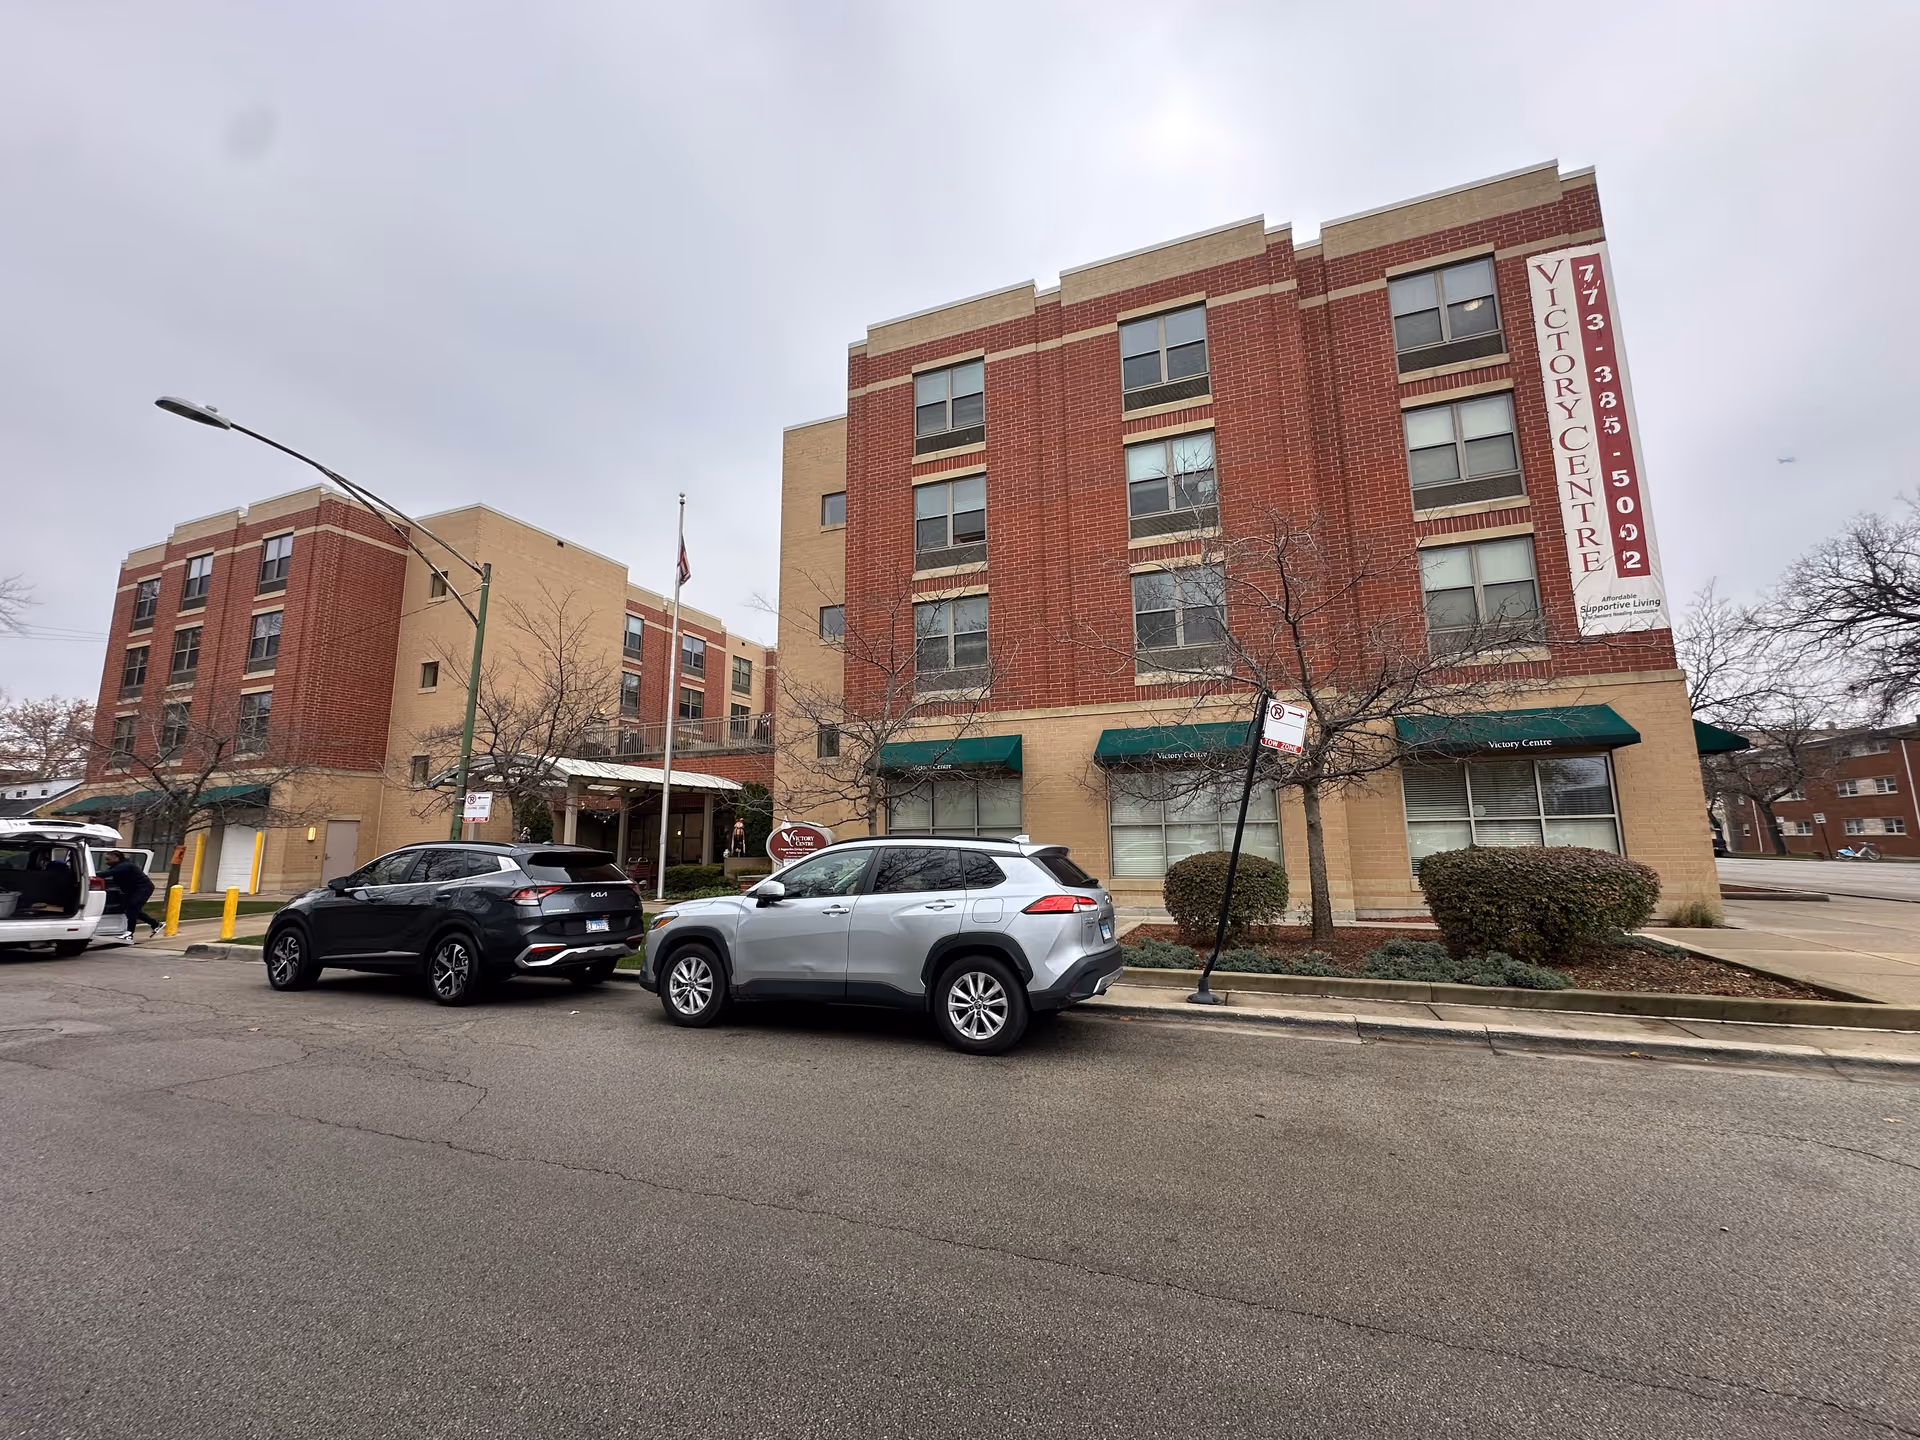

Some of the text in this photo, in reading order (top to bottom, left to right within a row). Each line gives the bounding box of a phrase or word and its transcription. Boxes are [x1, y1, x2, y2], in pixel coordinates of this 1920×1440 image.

[1532, 259, 1605, 574] VICTORY CENTRE
[1601, 593, 1638, 603] Affordable
[1580, 599, 1661, 614] Supportive Living
[1264, 738, 1298, 752] TOW ZONE
[1488, 738, 1553, 750] Victory Centre
[1157, 752, 1181, 761] Victory
